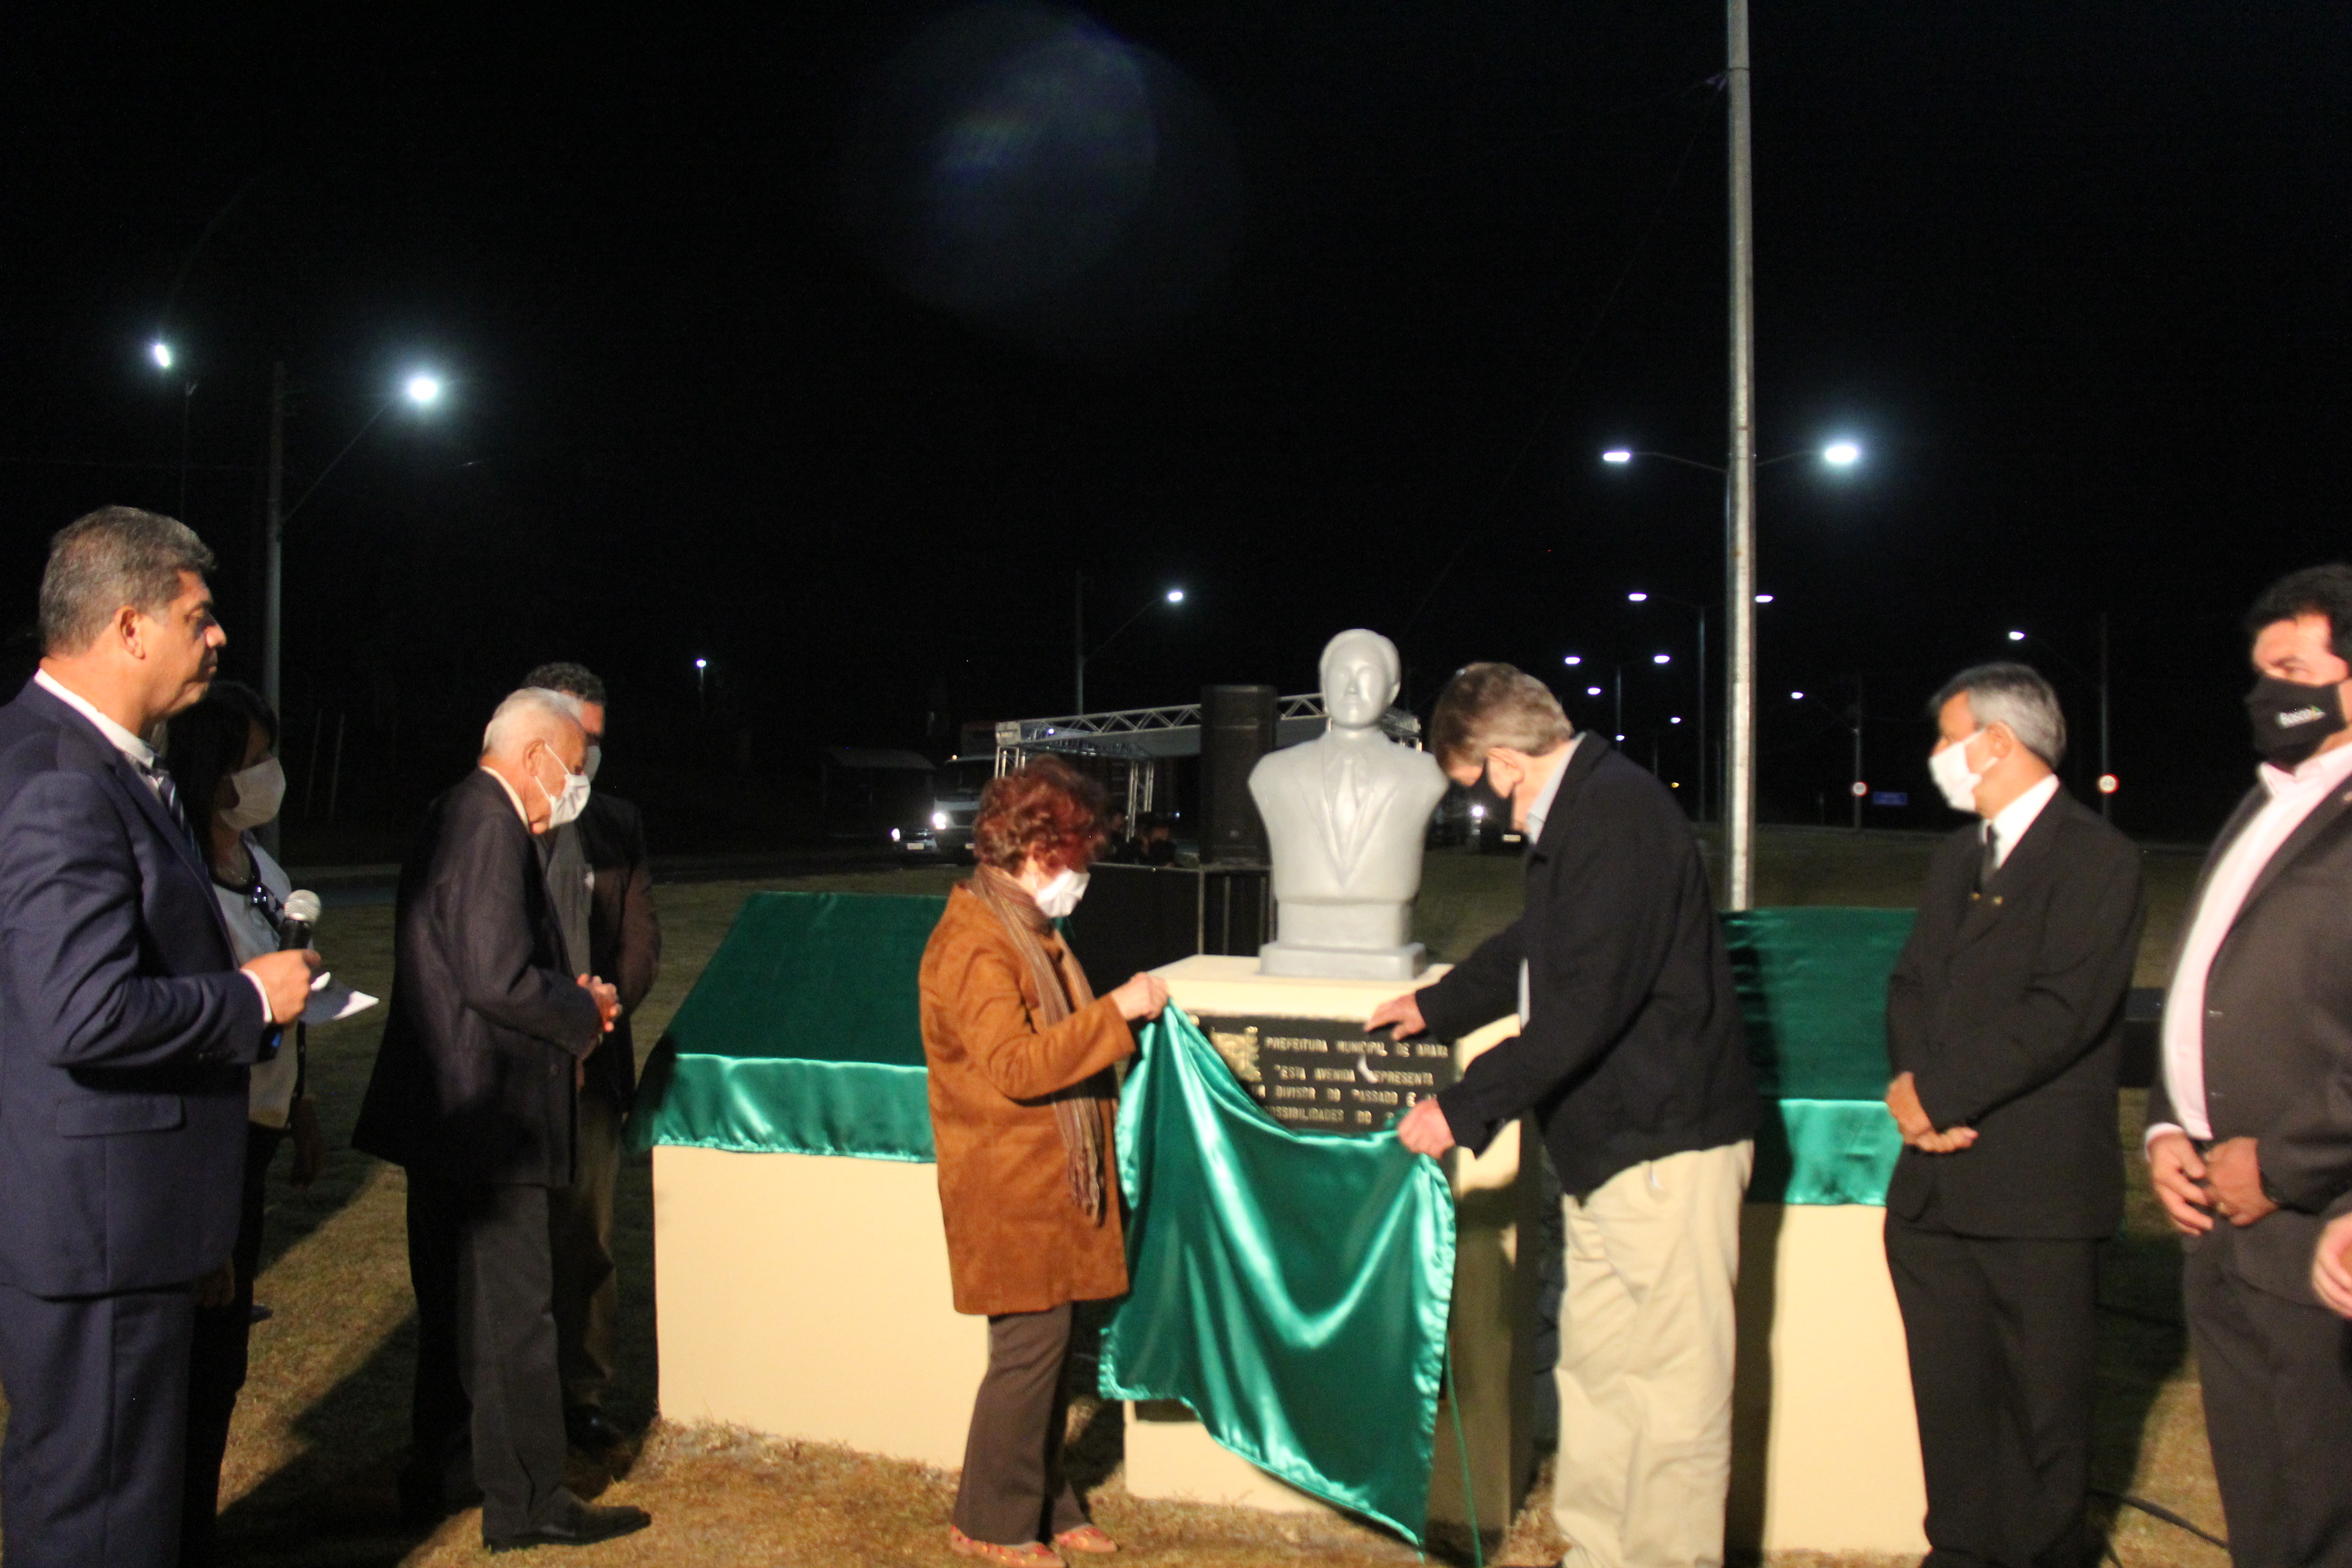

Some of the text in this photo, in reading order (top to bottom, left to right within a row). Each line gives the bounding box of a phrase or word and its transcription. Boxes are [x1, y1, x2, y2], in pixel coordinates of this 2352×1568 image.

[1265, 1036, 1328, 1053] PREFEITURA
[1337, 1040, 1388, 1056] MUNICIPAL
[1395, 1043, 1410, 1057] DE
[1314, 1067, 1356, 1082] AVENIDA
[1370, 1070, 1434, 1086] EPRESENTA
[1275, 1085, 1316, 1100] DIVISOR
[1327, 1087, 1341, 1102] DO
[1351, 1089, 1398, 1105] PASSADO
[1355, 1110, 1372, 1125] DO
